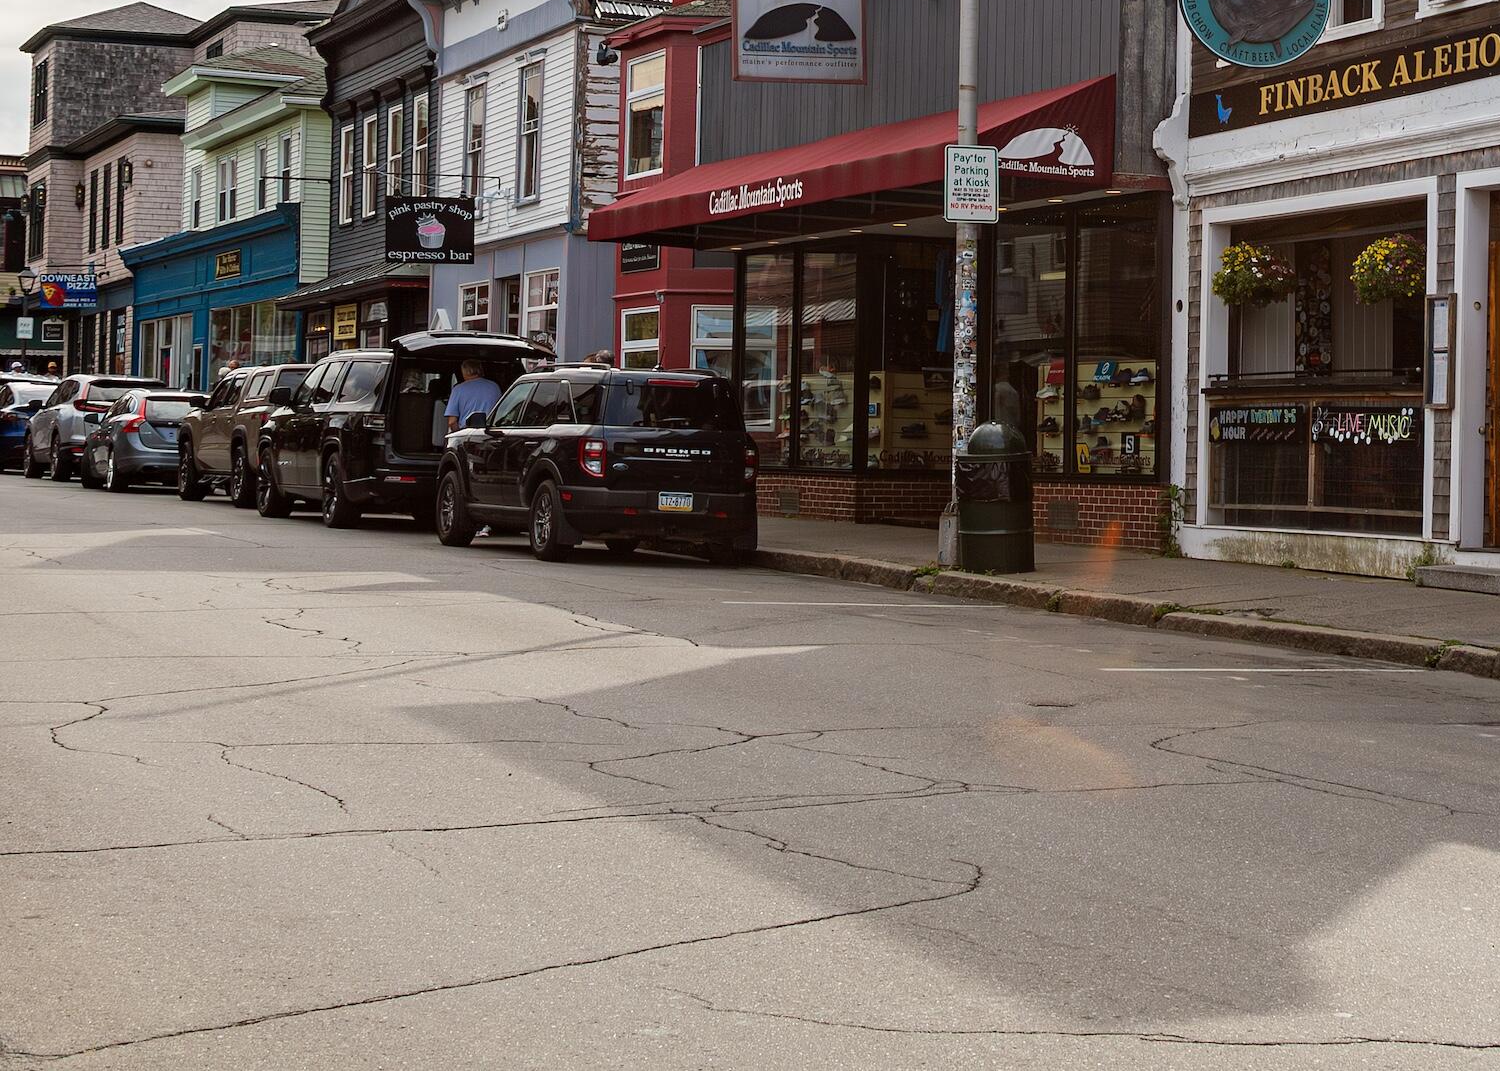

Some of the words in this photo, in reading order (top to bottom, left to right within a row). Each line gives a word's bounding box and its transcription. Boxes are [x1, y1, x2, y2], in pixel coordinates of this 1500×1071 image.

[1191, 11, 1214, 40] CHOW
[1287, 33, 1314, 56] LOCAL
[1311, 2, 1326, 31] FLAIR
[742, 40, 781, 53] Cadillac
[781, 42, 825, 54] Mountain
[826, 43, 857, 57] Sports
[1219, 41, 1249, 61] CRAFT
[1252, 51, 1276, 62] BEER
[1259, 60, 1382, 116] FINBACK
[953, 153, 971, 165] Pay
[973, 153, 987, 164] for
[954, 165, 989, 177] Parking
[1029, 162, 1067, 175] Mountain
[1068, 166, 1095, 178] Sports
[953, 178, 962, 186] at
[966, 178, 990, 187] Kiosk
[709, 190, 739, 214] Cadillac
[739, 182, 775, 209] Mountain
[776, 177, 803, 207] Sports
[388, 203, 411, 220] pink
[414, 201, 447, 213] pastry
[449, 205, 473, 221] shop
[970, 203, 993, 212] Parking
[388, 249, 446, 262] espresso
[450, 250, 473, 261] bar
[40, 274, 96, 282] DOWNEAST
[66, 282, 96, 290] PIZZA
[1219, 409, 1249, 424] HAPPY
[1222, 426, 1246, 440] HOUR
[1337, 413, 1365, 433] LIVE
[1367, 414, 1411, 441] MUSIC
[643, 447, 711, 455] BRONCO
